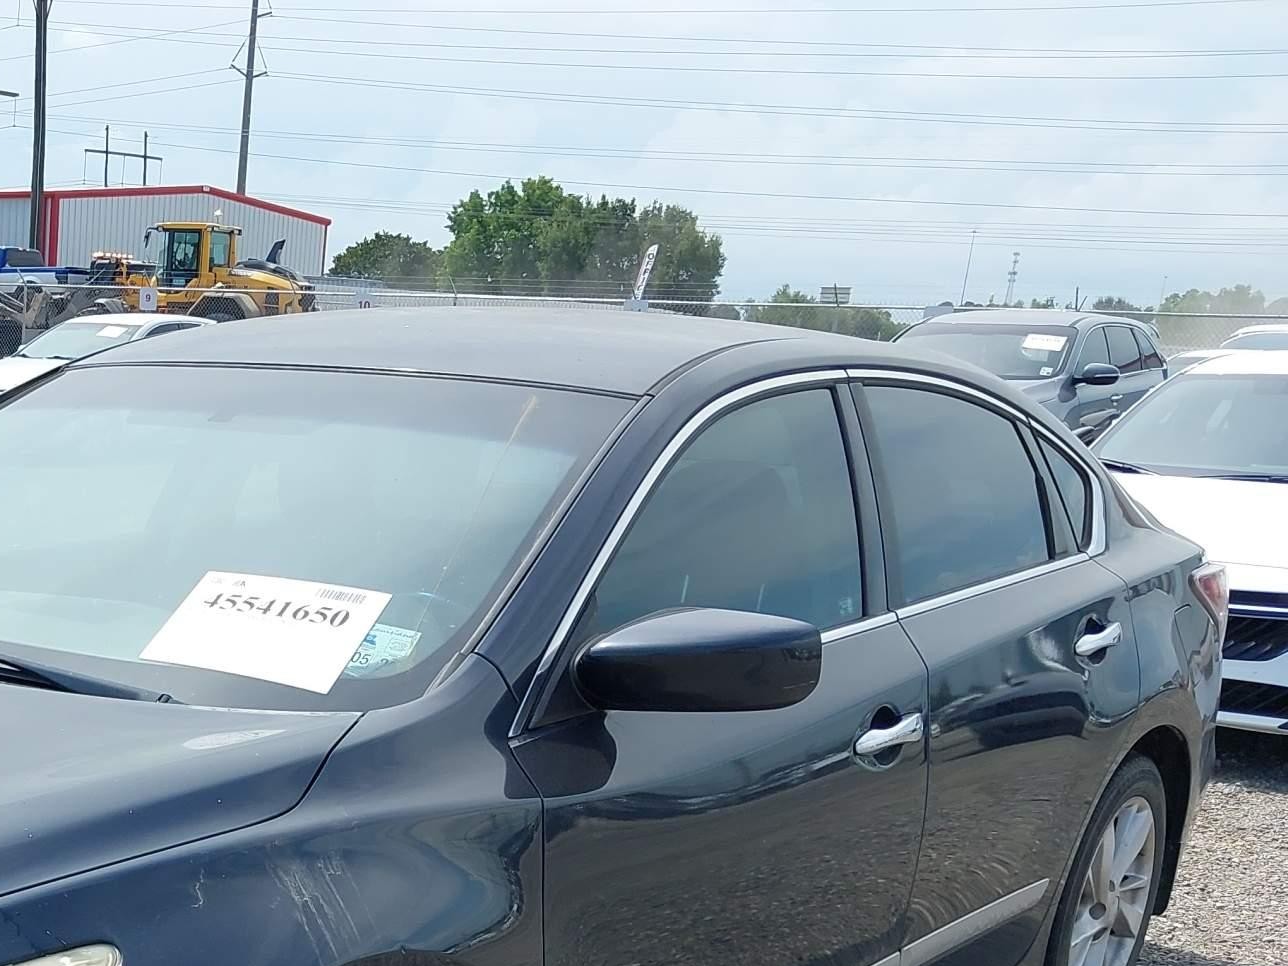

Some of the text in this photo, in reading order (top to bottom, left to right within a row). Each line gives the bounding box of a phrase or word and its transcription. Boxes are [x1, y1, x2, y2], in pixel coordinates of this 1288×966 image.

[358, 300, 371, 309] 10
[203, 592, 350, 628] 45541650
[351, 651, 372, 665] 05
